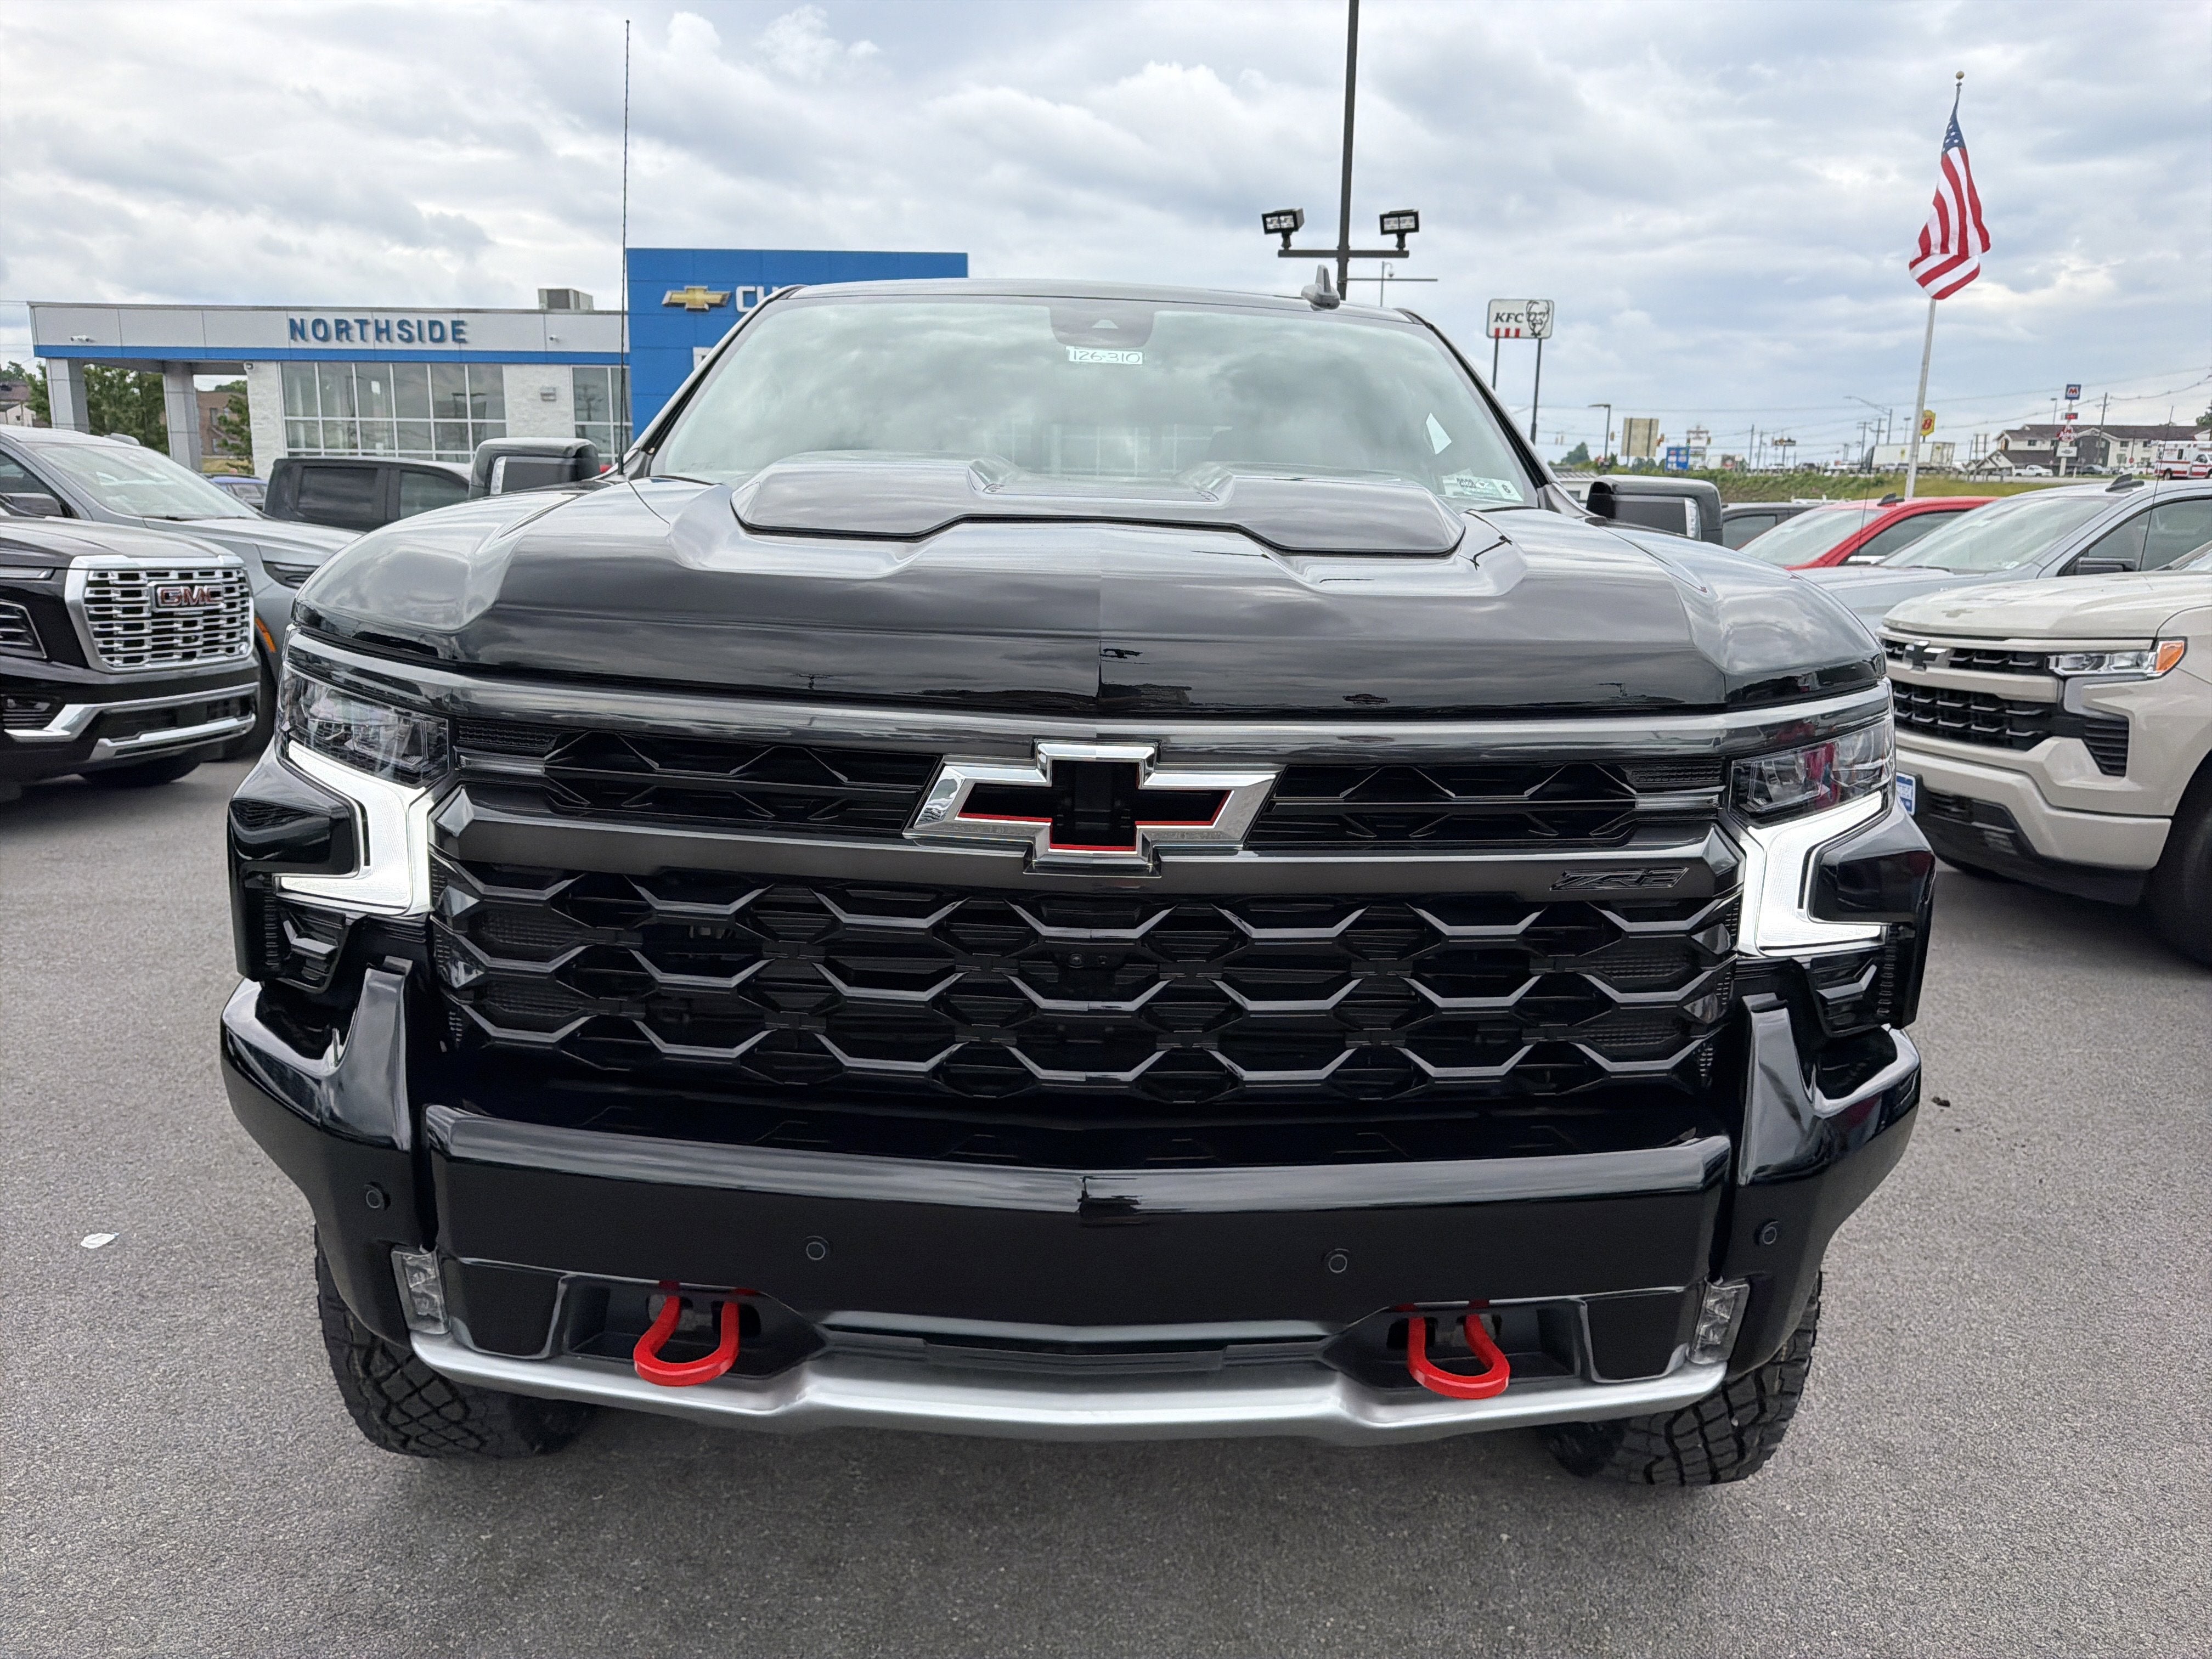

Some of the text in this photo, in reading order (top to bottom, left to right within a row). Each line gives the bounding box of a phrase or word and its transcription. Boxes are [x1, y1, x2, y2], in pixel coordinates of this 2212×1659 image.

[1494, 312, 1524, 323] KFC
[289, 318, 468, 343] NORTHSIDE
[1074, 350, 1141, 363] 126-310
[157, 585, 222, 606] GMC
[1549, 867, 1690, 891] ZR2
